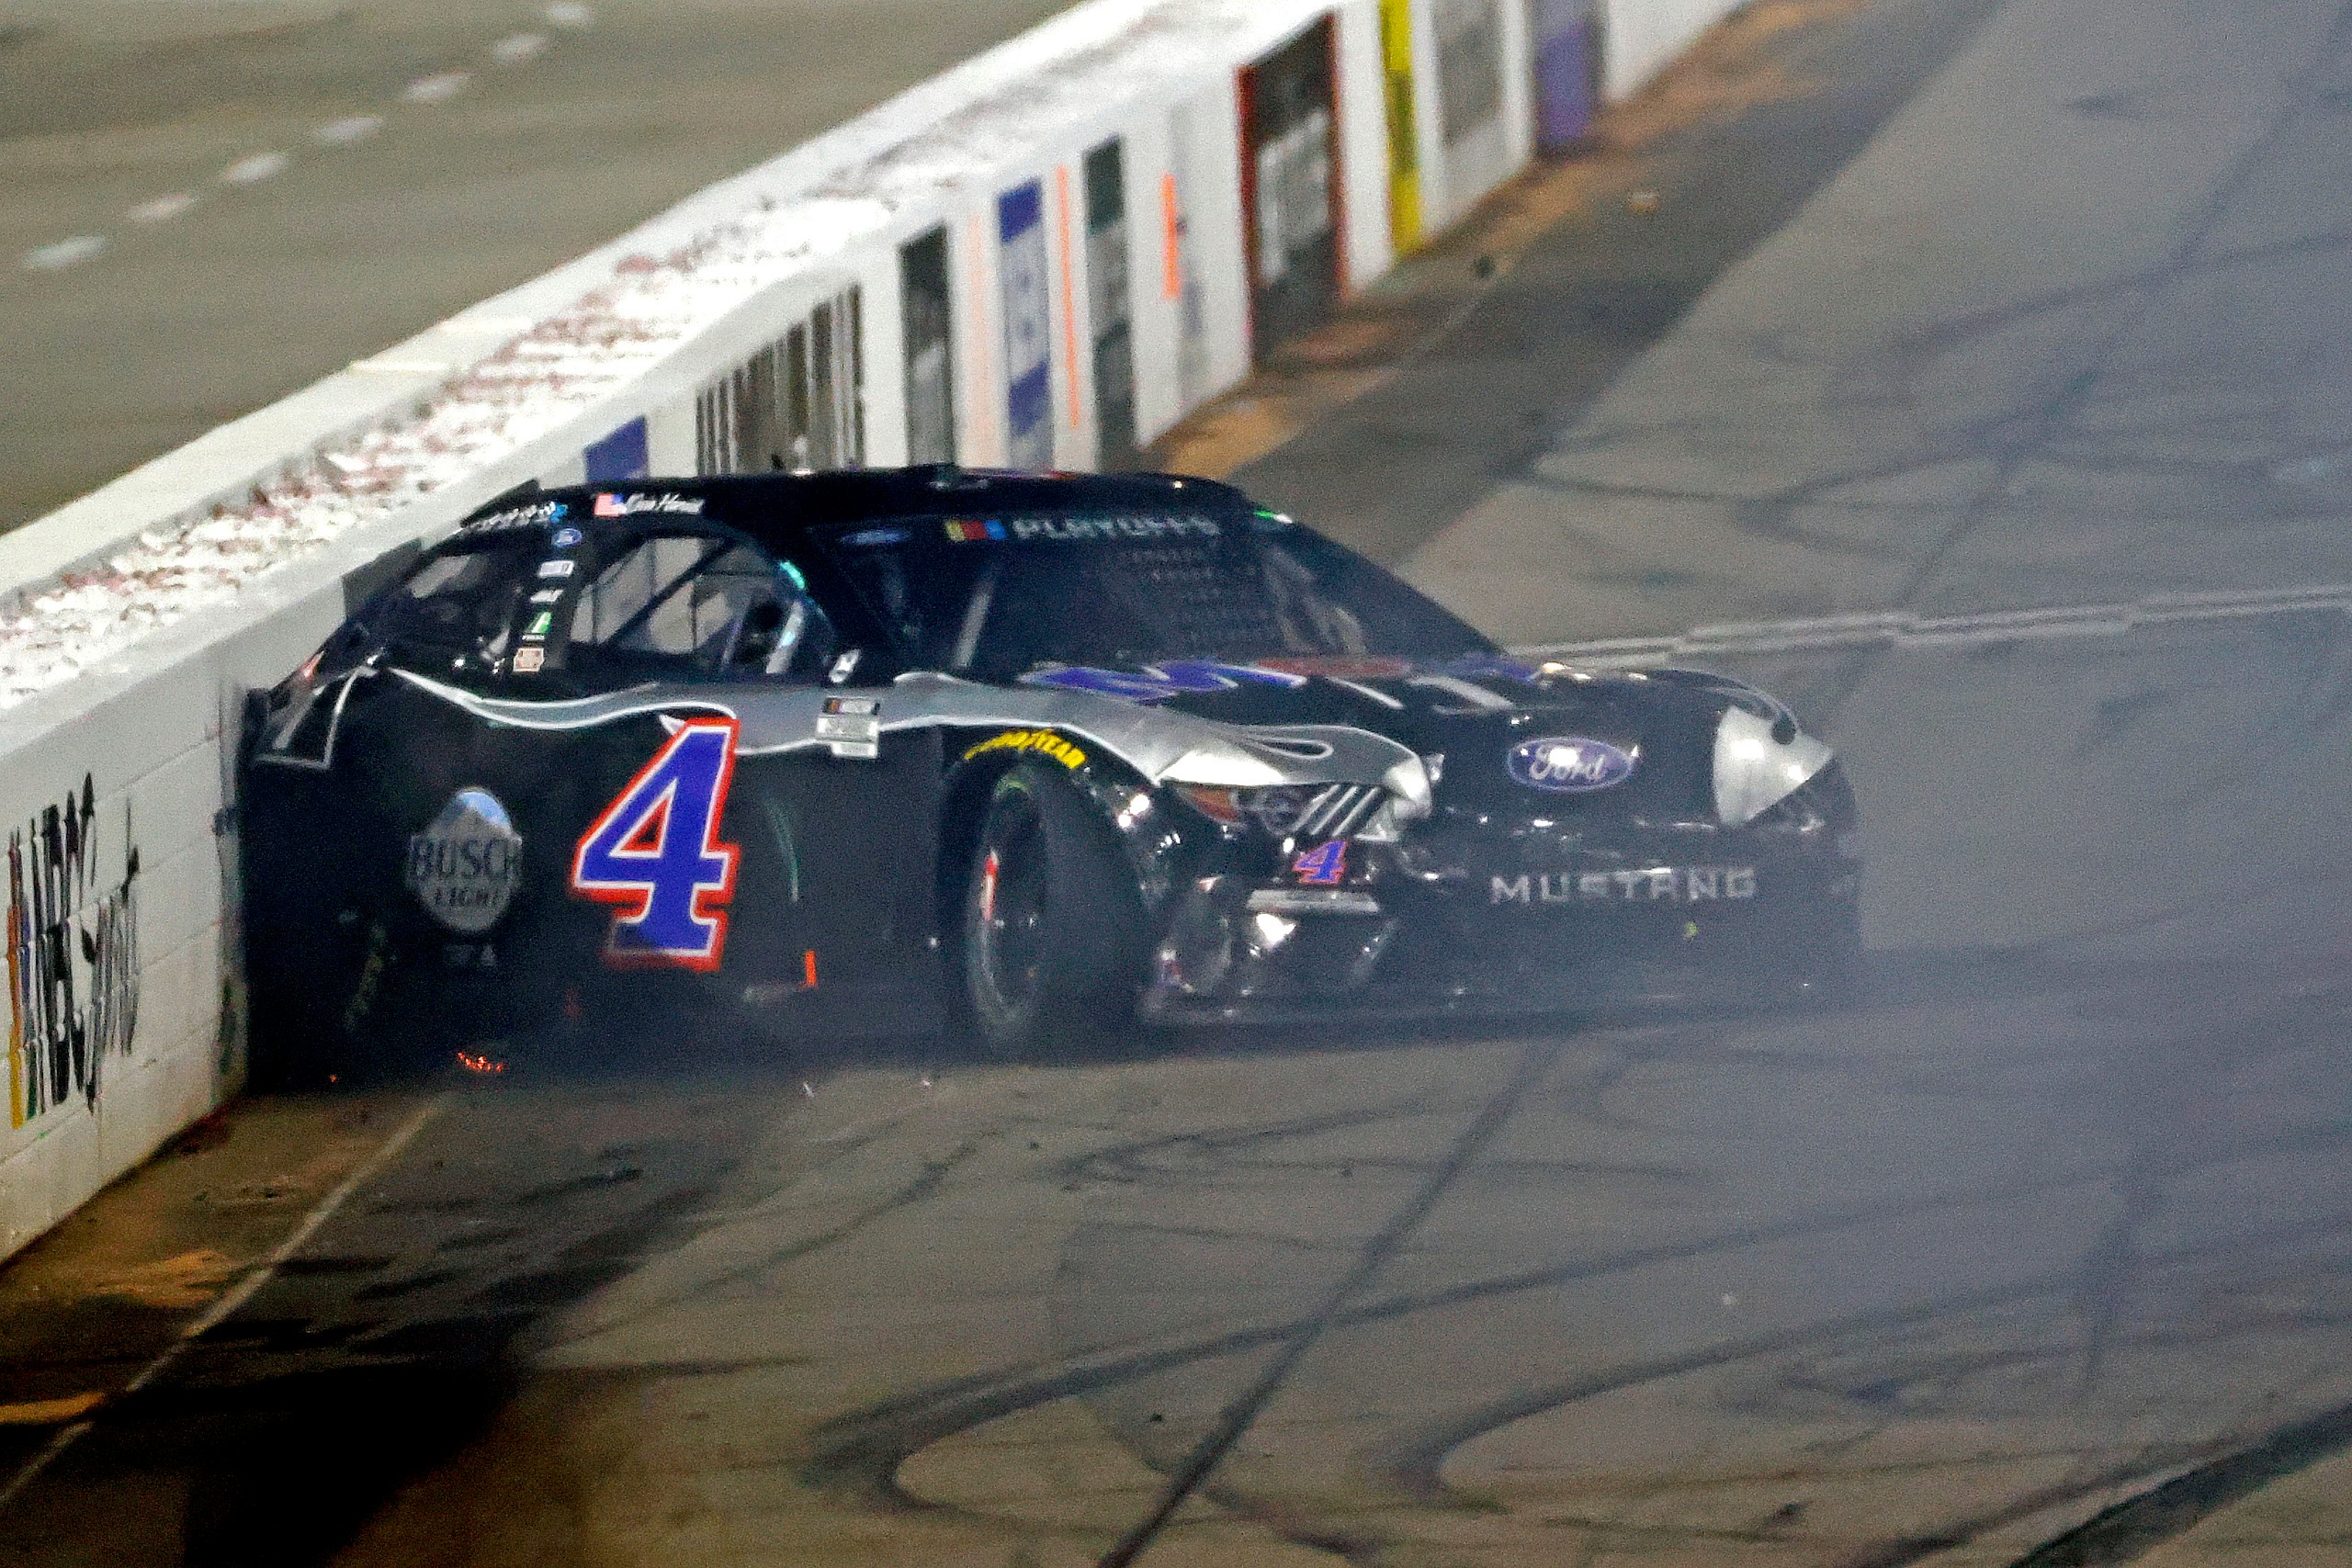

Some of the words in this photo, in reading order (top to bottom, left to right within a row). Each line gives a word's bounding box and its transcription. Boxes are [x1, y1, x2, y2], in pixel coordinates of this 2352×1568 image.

[1527, 742, 1610, 781] Ford
[412, 835, 523, 882] BUSCH
[568, 715, 741, 973] 4
[1291, 840, 1349, 886] 4
[1490, 868, 1756, 906] MUSTANG
